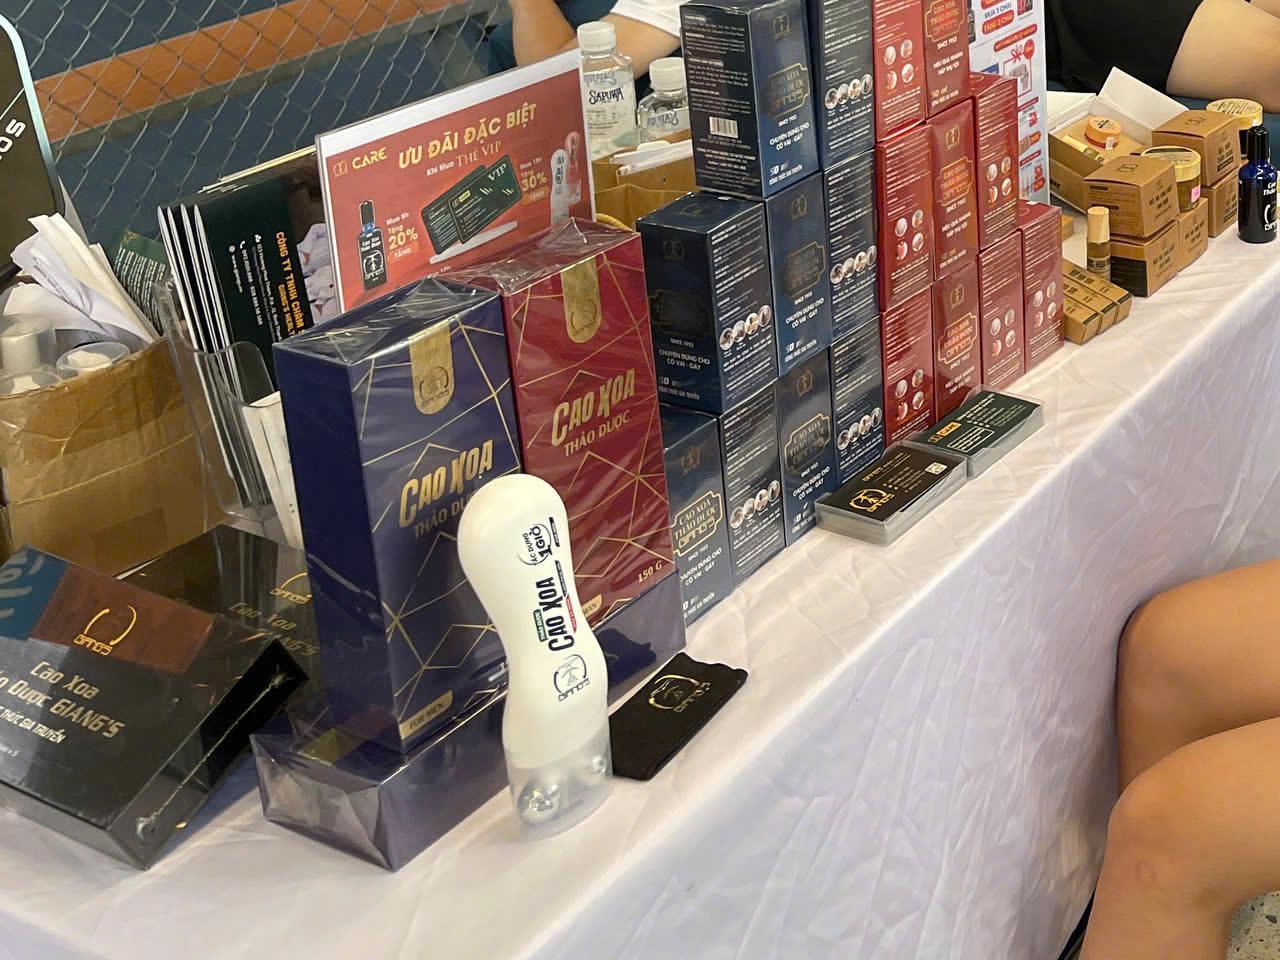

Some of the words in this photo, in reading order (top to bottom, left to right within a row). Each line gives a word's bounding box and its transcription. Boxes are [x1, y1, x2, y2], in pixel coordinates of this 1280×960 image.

[464, 117, 501, 146] ĐẶC
[506, 102, 536, 129] BIỆT
[352, 147, 387, 170] CARE
[487, 163, 507, 181] VIP
[521, 171, 547, 191] 30%
[388, 227, 418, 250] 20%
[551, 399, 594, 447] CAO
[598, 368, 635, 418] XOA
[564, 429, 595, 457] THẢO
[400, 475, 445, 528] CAO
[450, 440, 494, 495] XOA
[680, 509, 695, 526] CAO
[696, 499, 711, 515] XOA
[637, 566, 654, 584] 150
[655, 561, 663, 574] G
[536, 577, 563, 611] XOA
[548, 615, 575, 652] CAO
[31, 661, 60, 685] Cao
[63, 675, 100, 700] Xoa
[8, 680, 53, 708] Dược
[50, 699, 125, 738] GIANG'S
